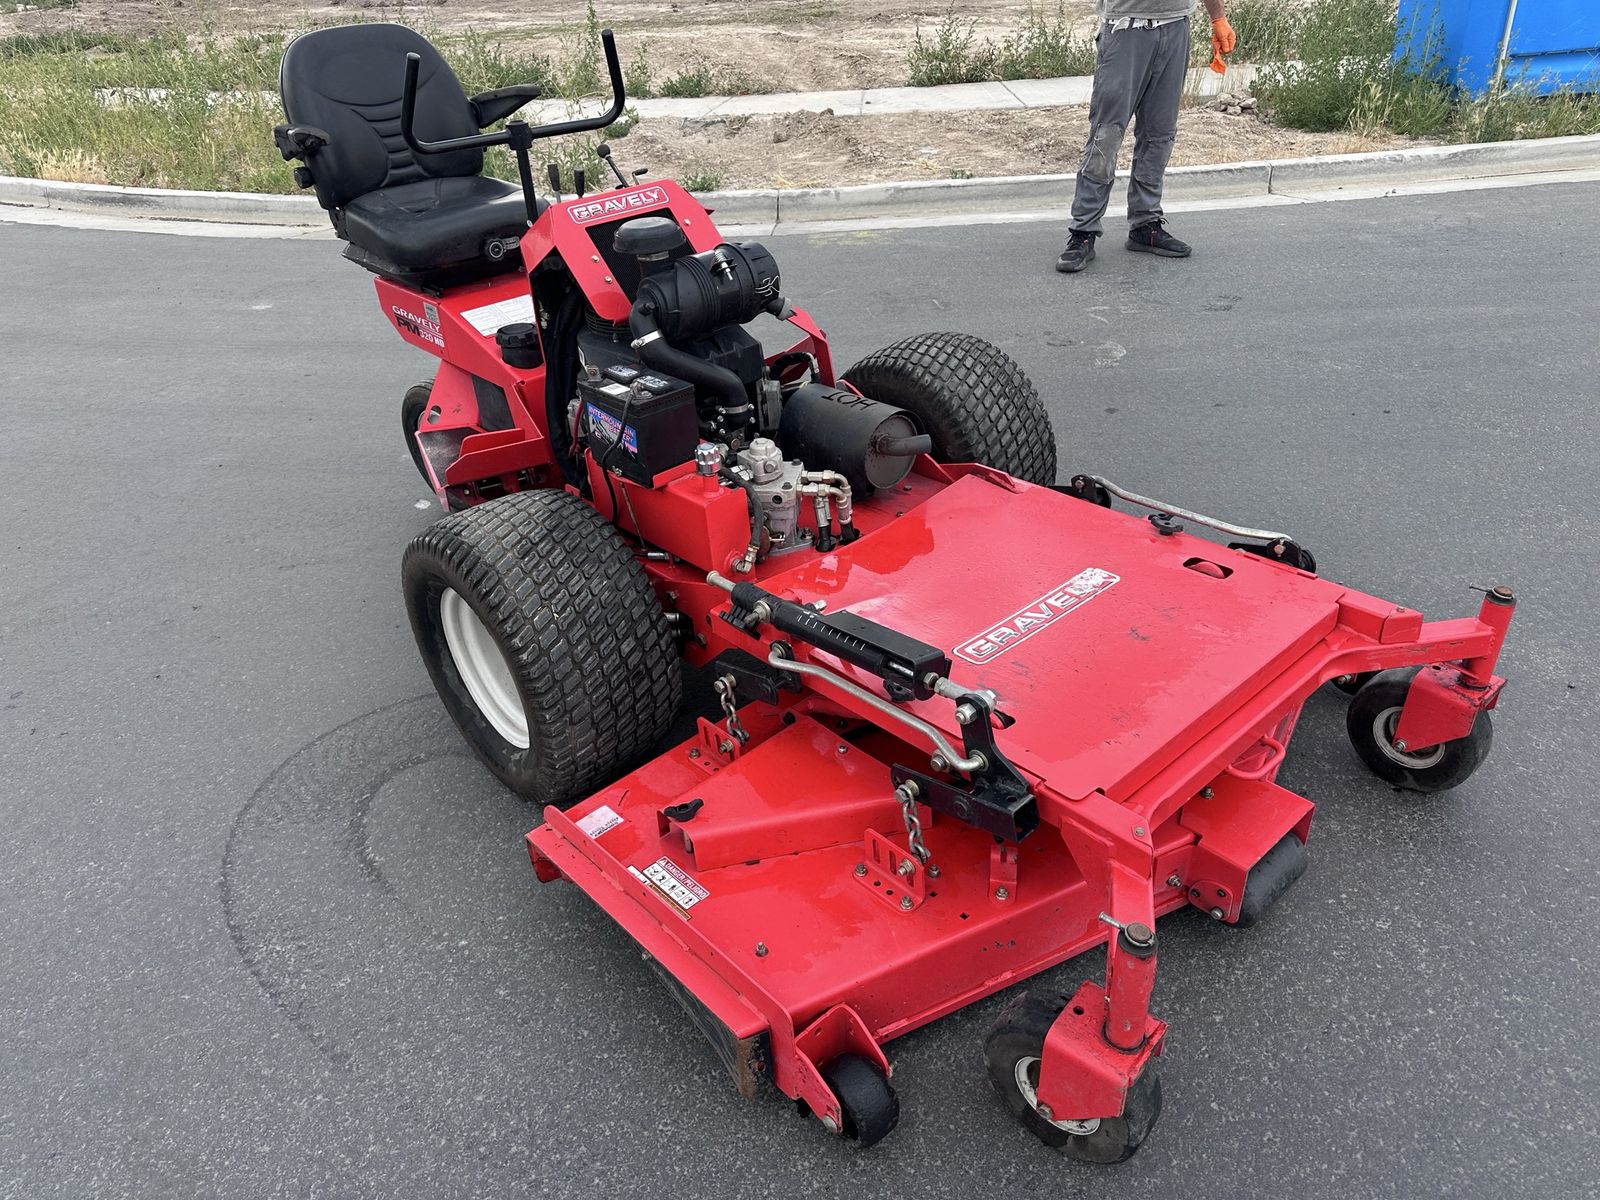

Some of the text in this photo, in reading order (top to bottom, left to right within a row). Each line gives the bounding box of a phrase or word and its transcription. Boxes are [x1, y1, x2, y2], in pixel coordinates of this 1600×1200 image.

[572, 189, 661, 220] GRAVELY
[392, 305, 441, 333] GRAVELY
[821, 391, 878, 411] HOT
[588, 405, 634, 437] INTERMOUNAIN
[608, 424, 634, 443] BATERY
[665, 861, 708, 900] DANGER/PELIGRO
